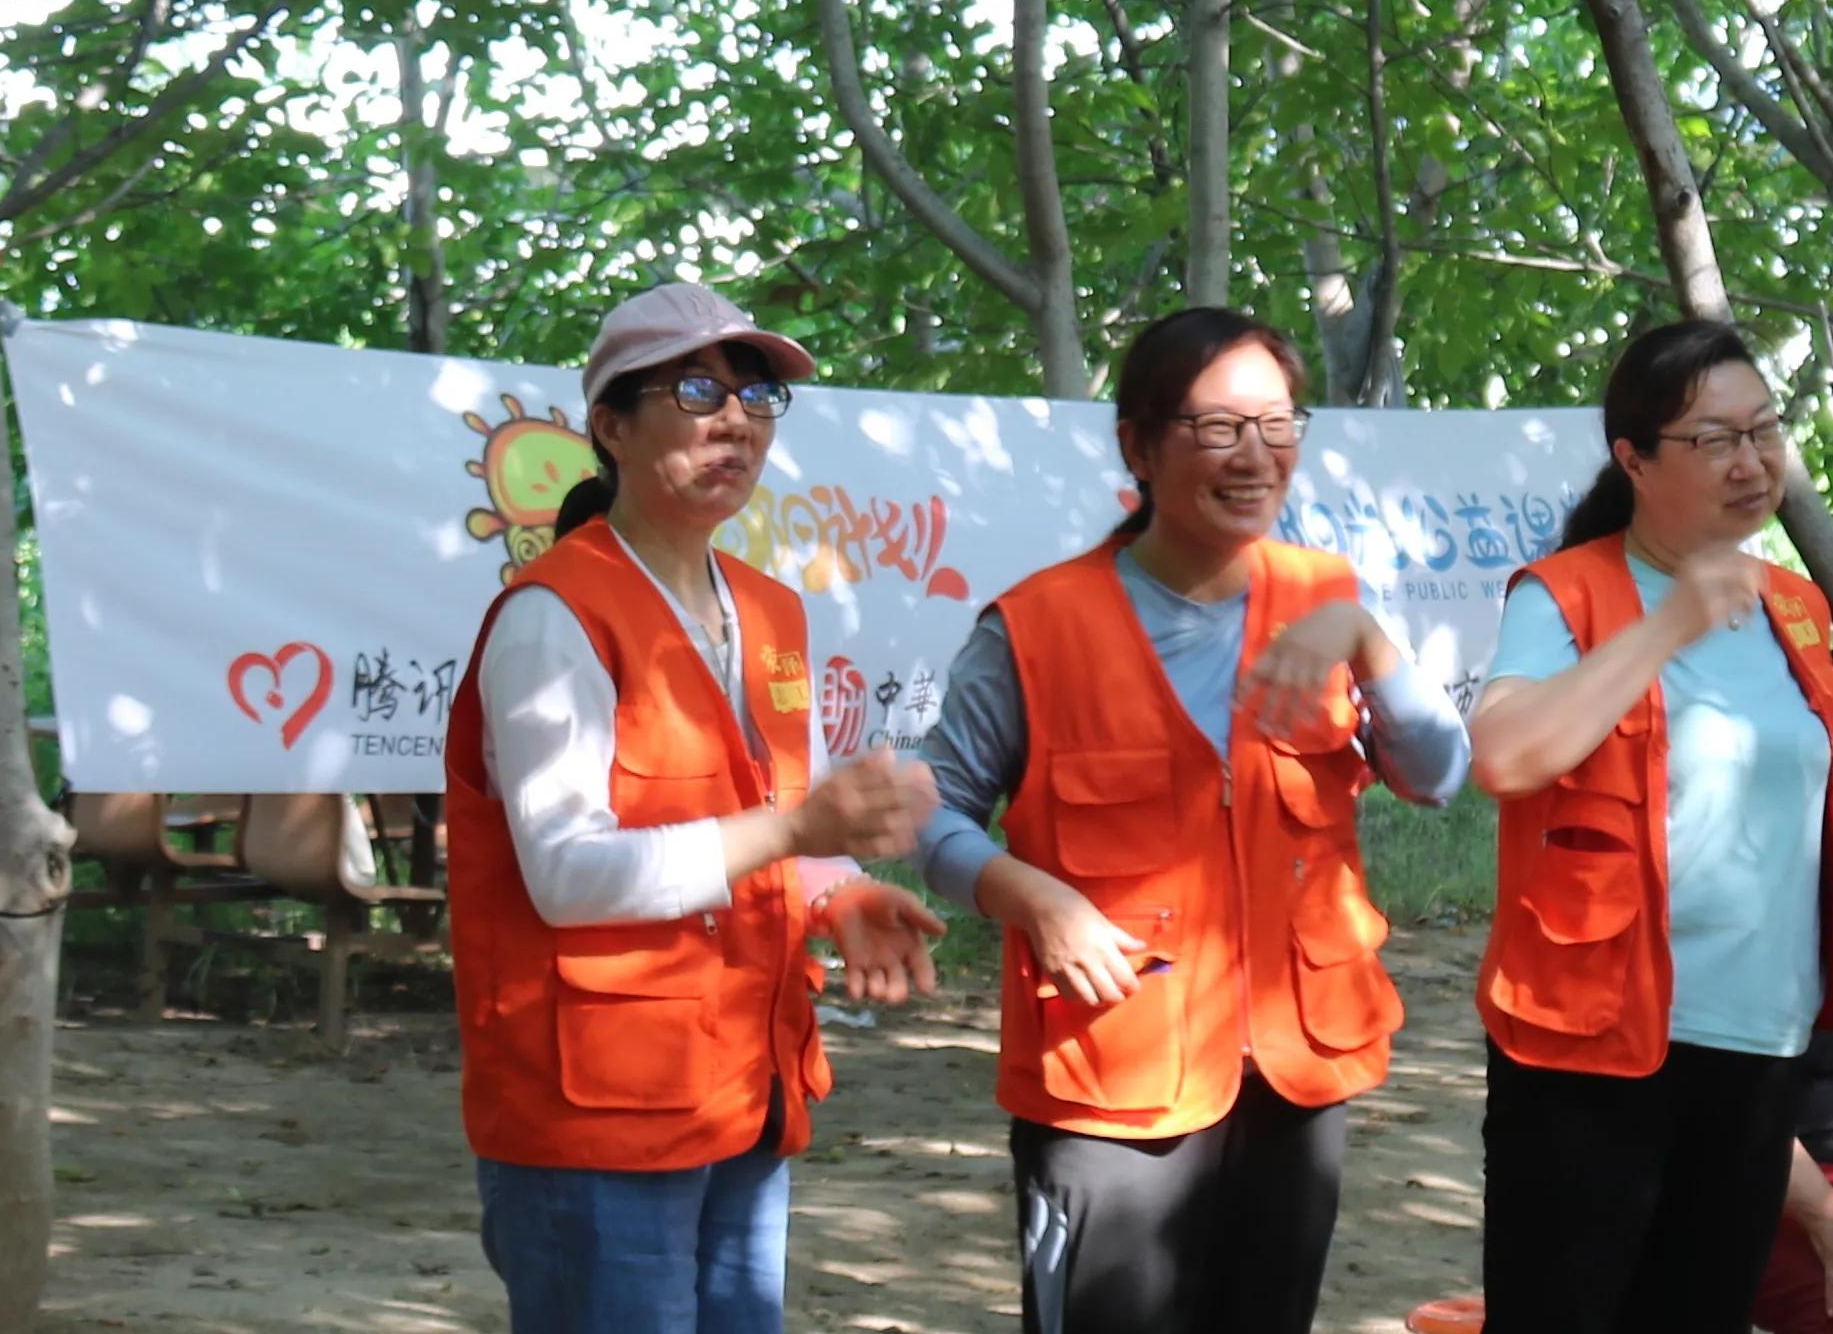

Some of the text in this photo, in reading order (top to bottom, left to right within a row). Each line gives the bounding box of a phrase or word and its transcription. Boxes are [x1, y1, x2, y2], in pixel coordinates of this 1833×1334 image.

[1405, 581, 1469, 602] PUBLIC
[352, 733, 445, 756] TENCEN
[867, 729, 923, 752] China
